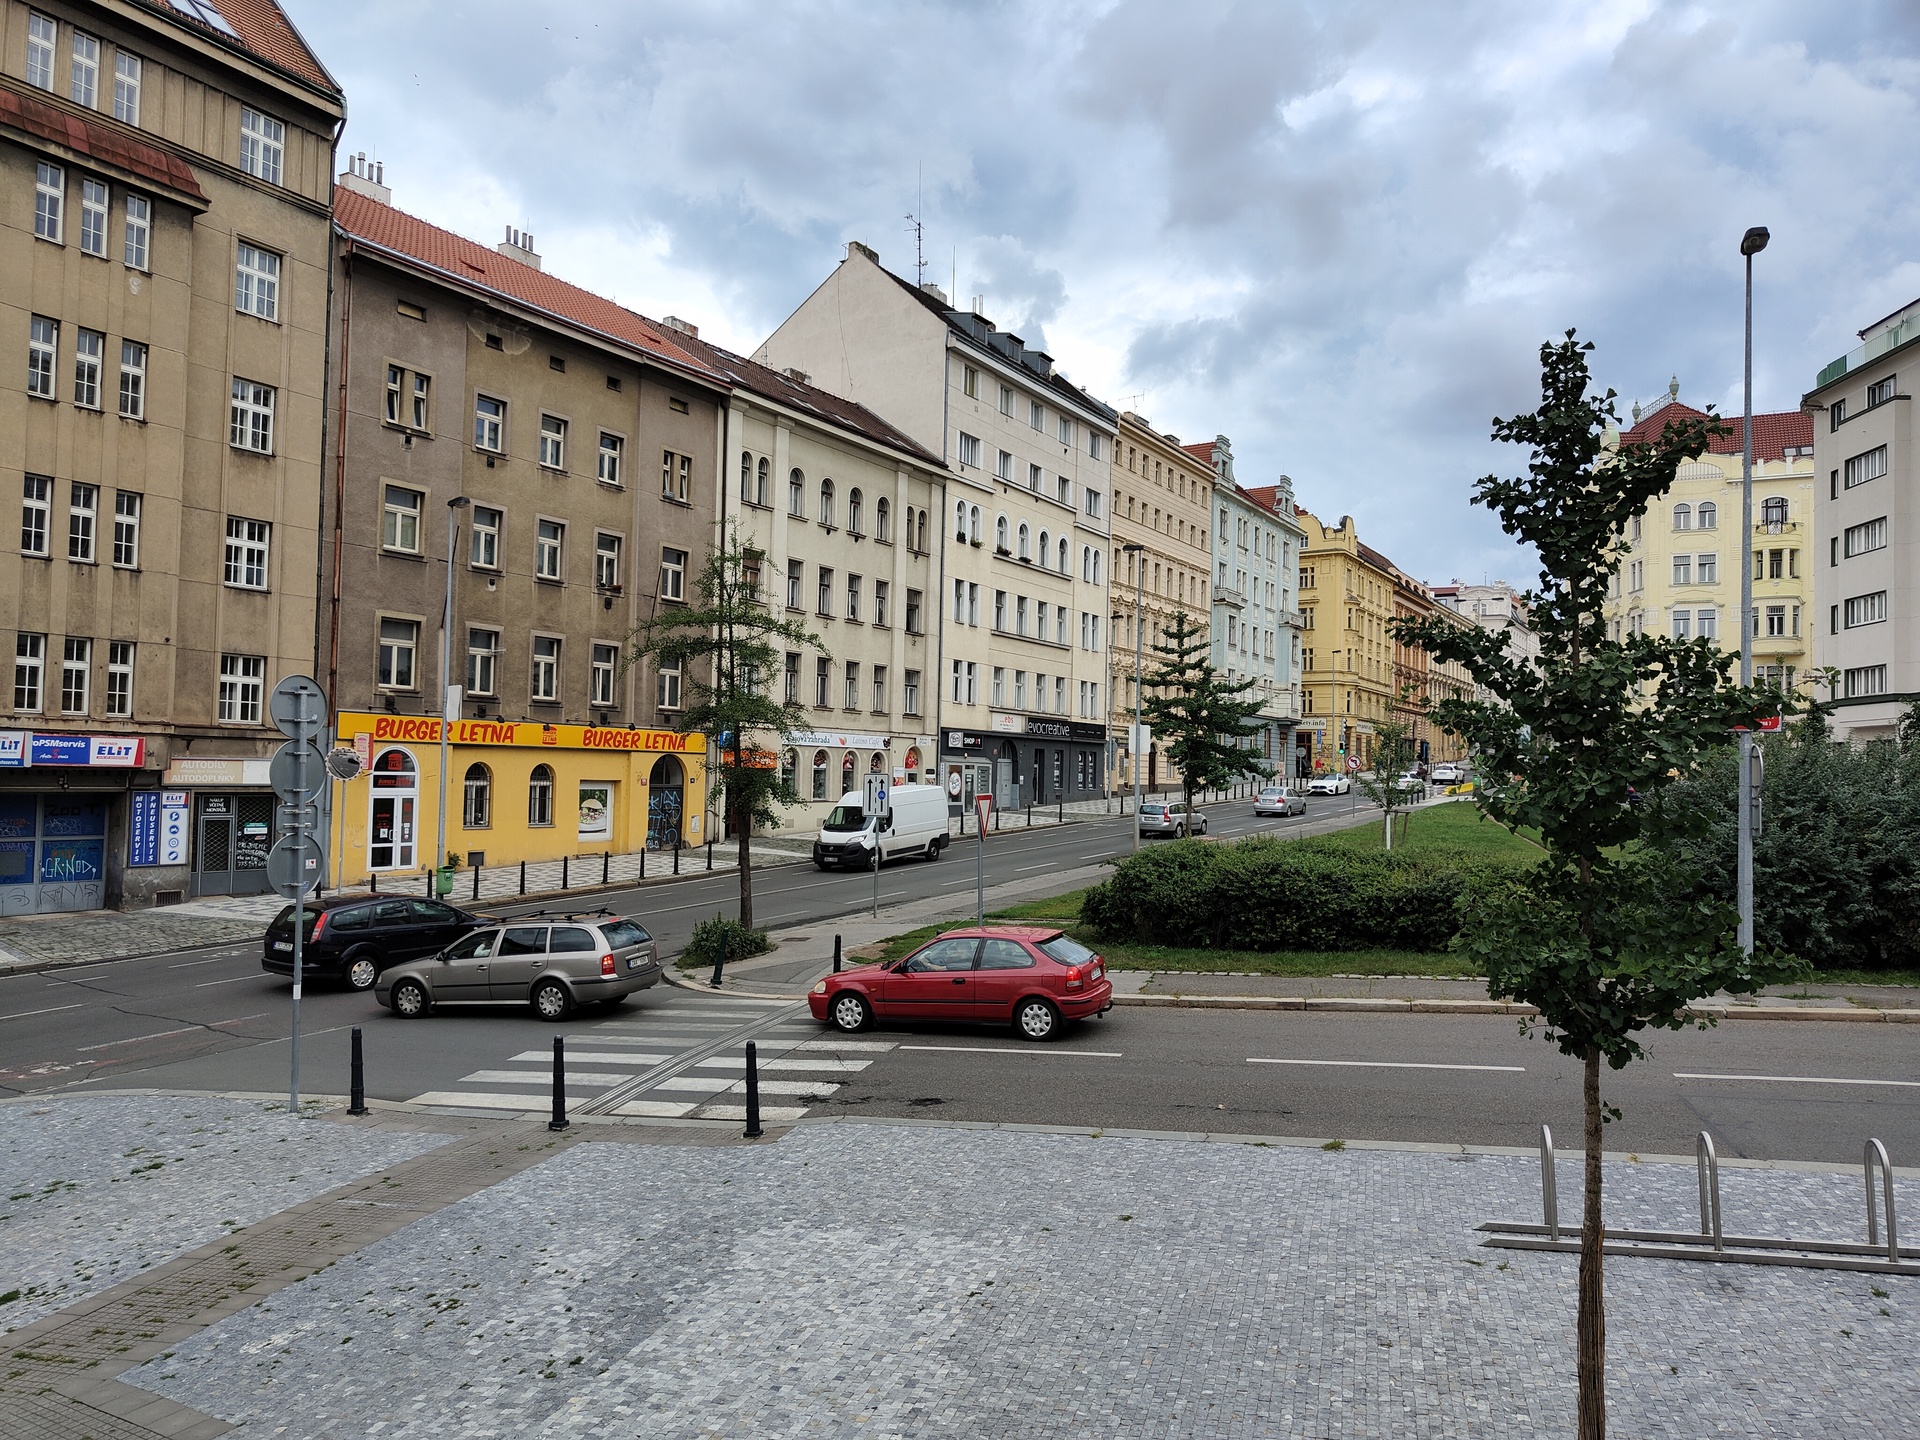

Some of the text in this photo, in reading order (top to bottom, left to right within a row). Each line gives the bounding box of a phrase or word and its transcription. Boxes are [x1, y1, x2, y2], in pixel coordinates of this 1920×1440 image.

[375, 717, 521, 744] BURGER LETNÁ
[1028, 722, 1070, 737] evocreative
[0, 740, 20, 750] LiT
[582, 729, 641, 749] BURGER
[852, 736, 881, 748] Latino Café
[181, 759, 228, 769] AUTODÍLY
[171, 772, 235, 782] AUTODOPLŇKY
[134, 795, 143, 862] MOTOSERVIS
[148, 795, 157, 862] PNEUSERVIS
